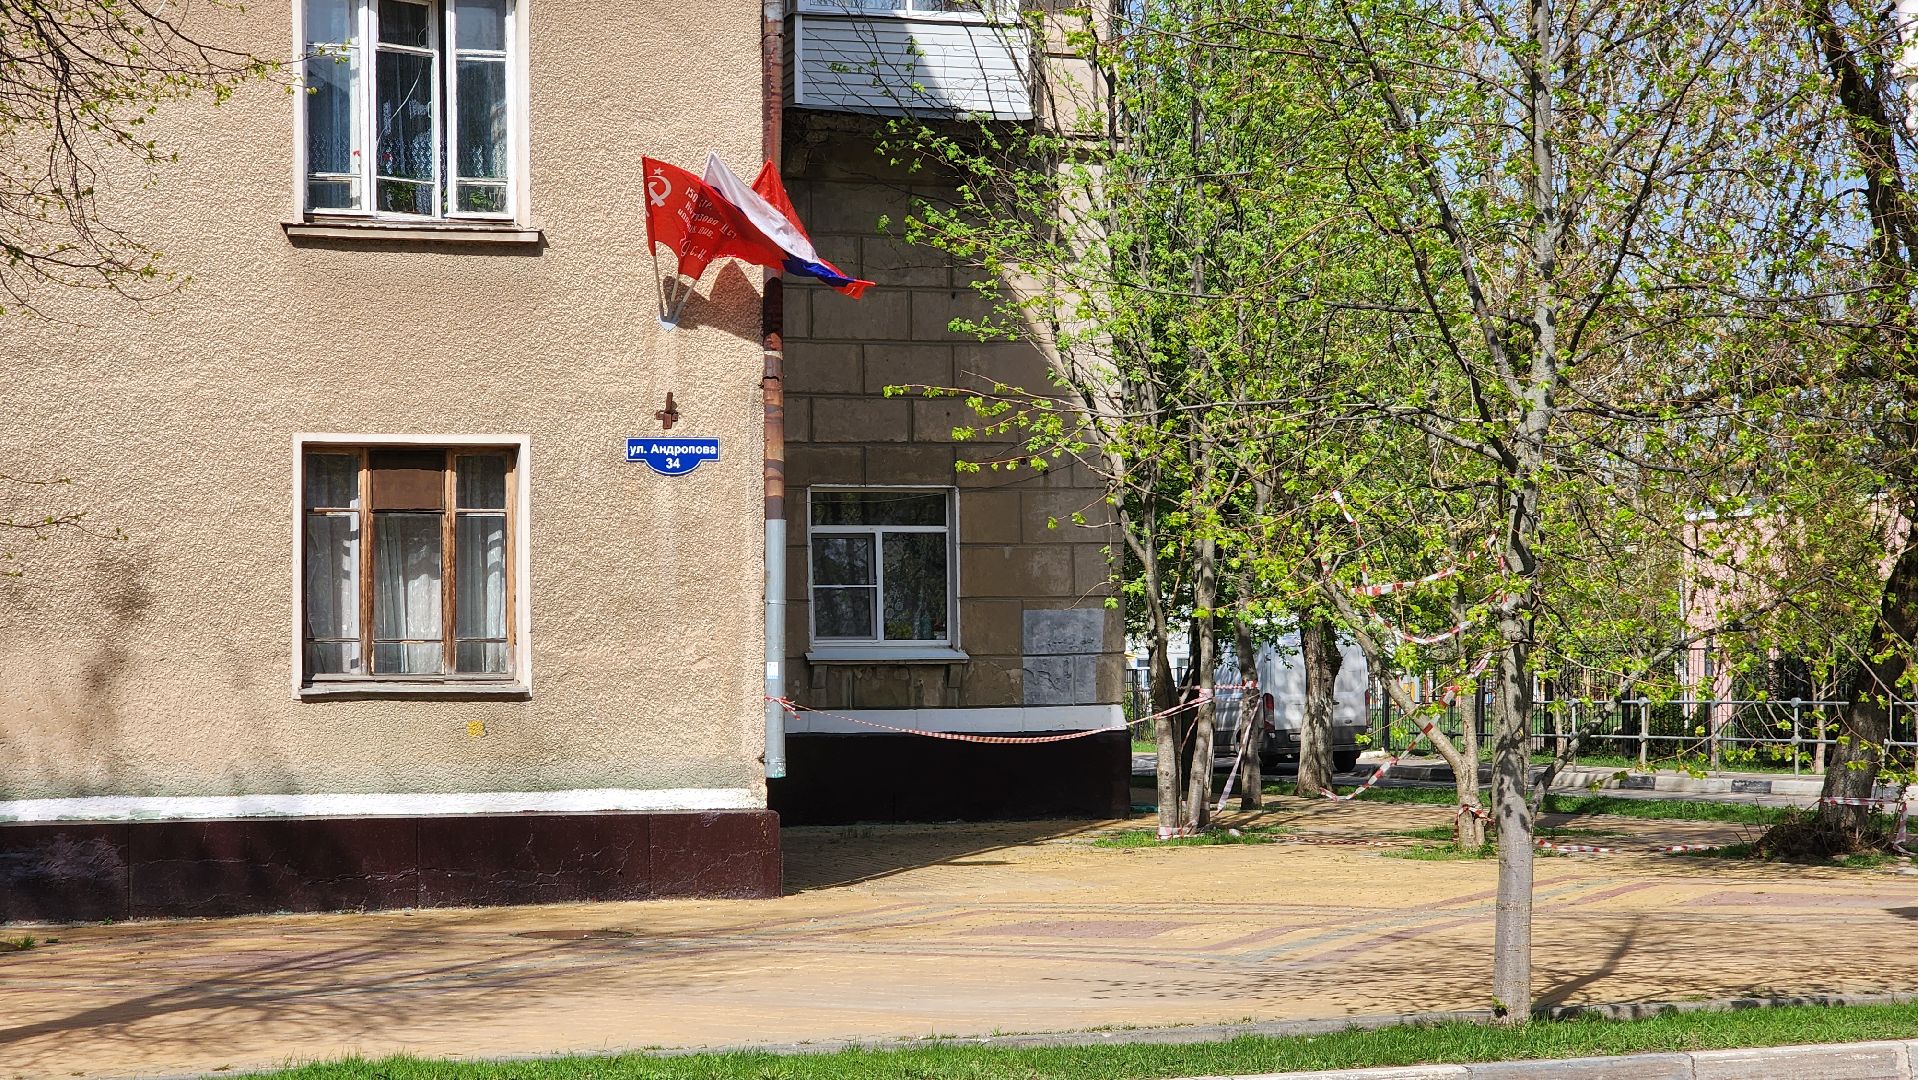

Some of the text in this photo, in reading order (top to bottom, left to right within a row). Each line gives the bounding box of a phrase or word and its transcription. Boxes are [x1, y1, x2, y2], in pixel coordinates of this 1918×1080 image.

[685, 187, 698, 202] 150
[629, 444, 716, 456] ул. Андропова
[665, 457, 680, 469] 34
